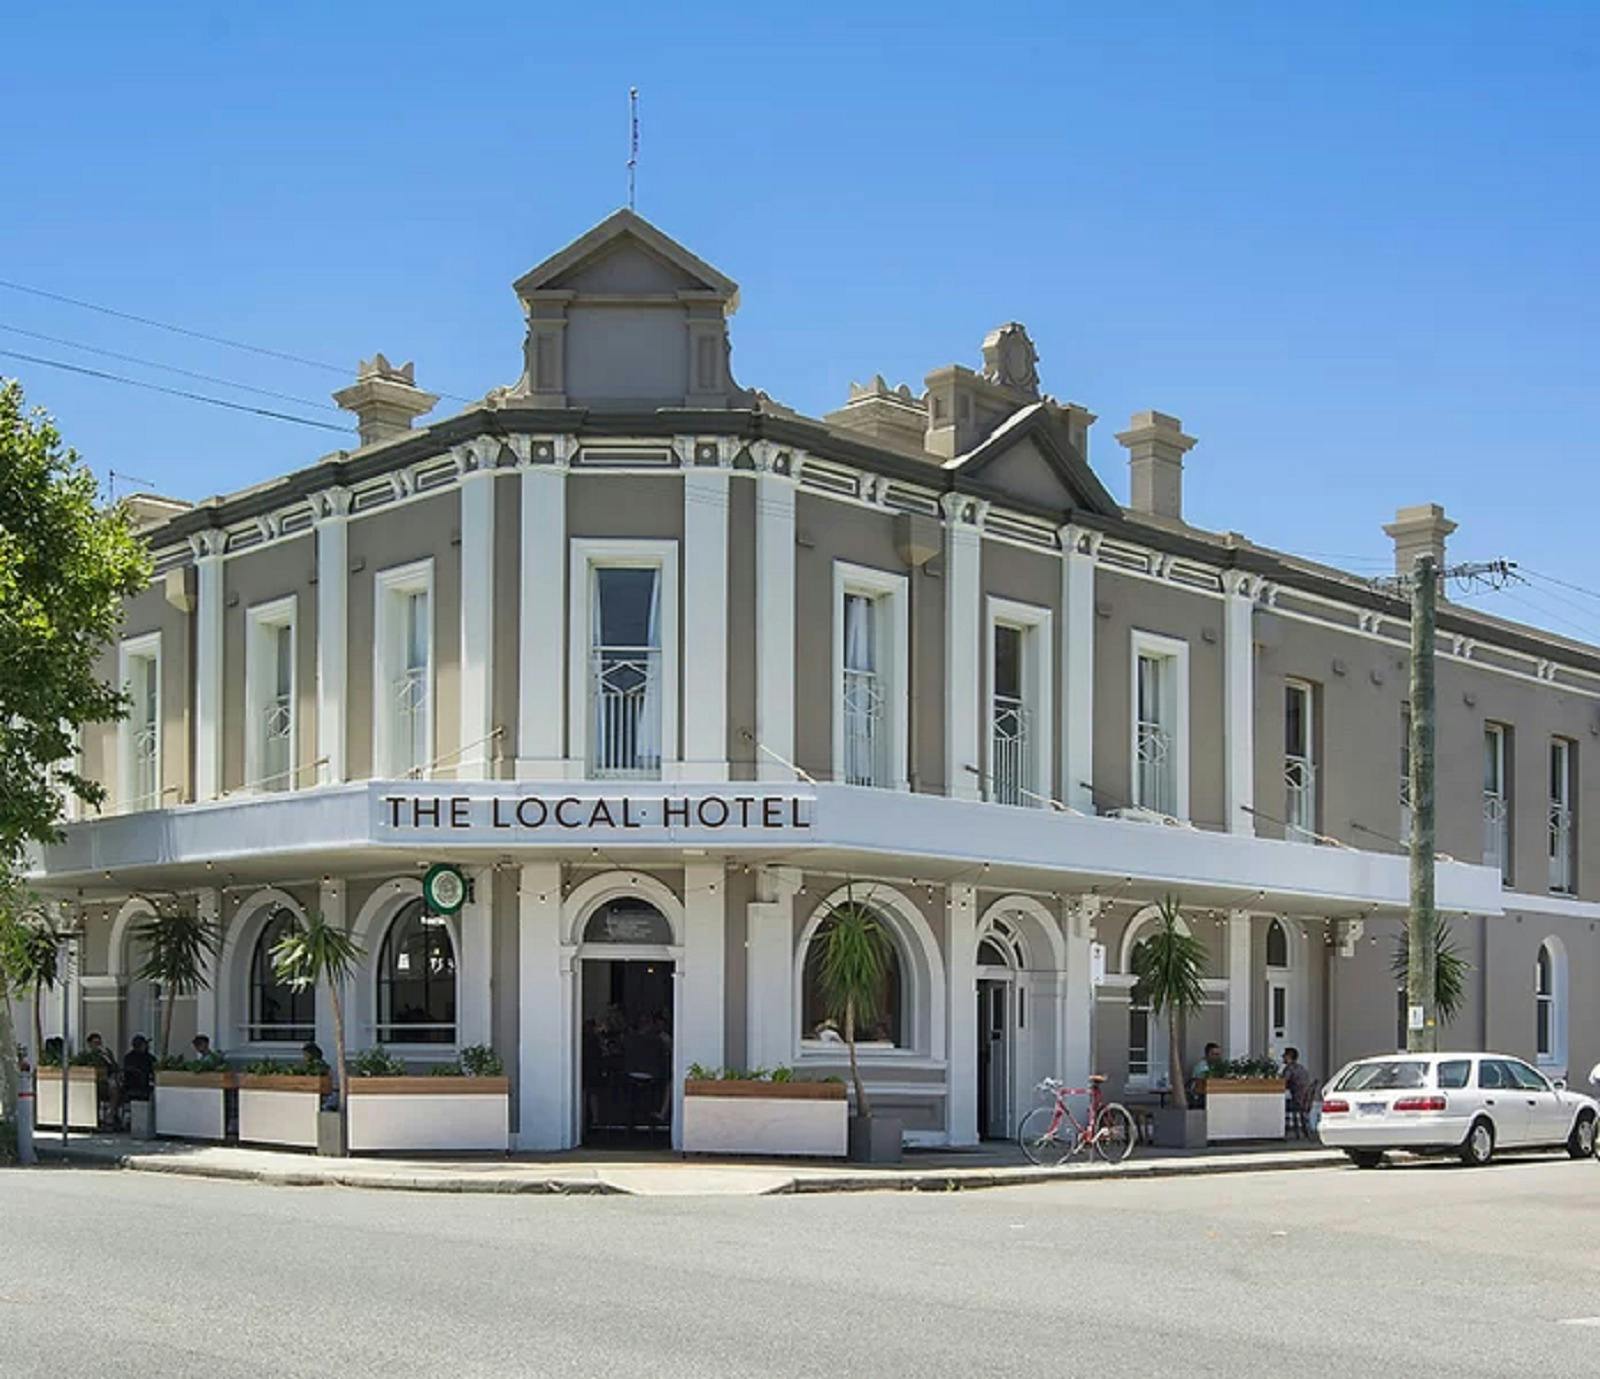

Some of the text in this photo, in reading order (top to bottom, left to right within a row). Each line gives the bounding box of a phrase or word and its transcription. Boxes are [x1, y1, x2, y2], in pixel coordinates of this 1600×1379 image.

[386, 797, 810, 828] THE LOCAL HOTEL
